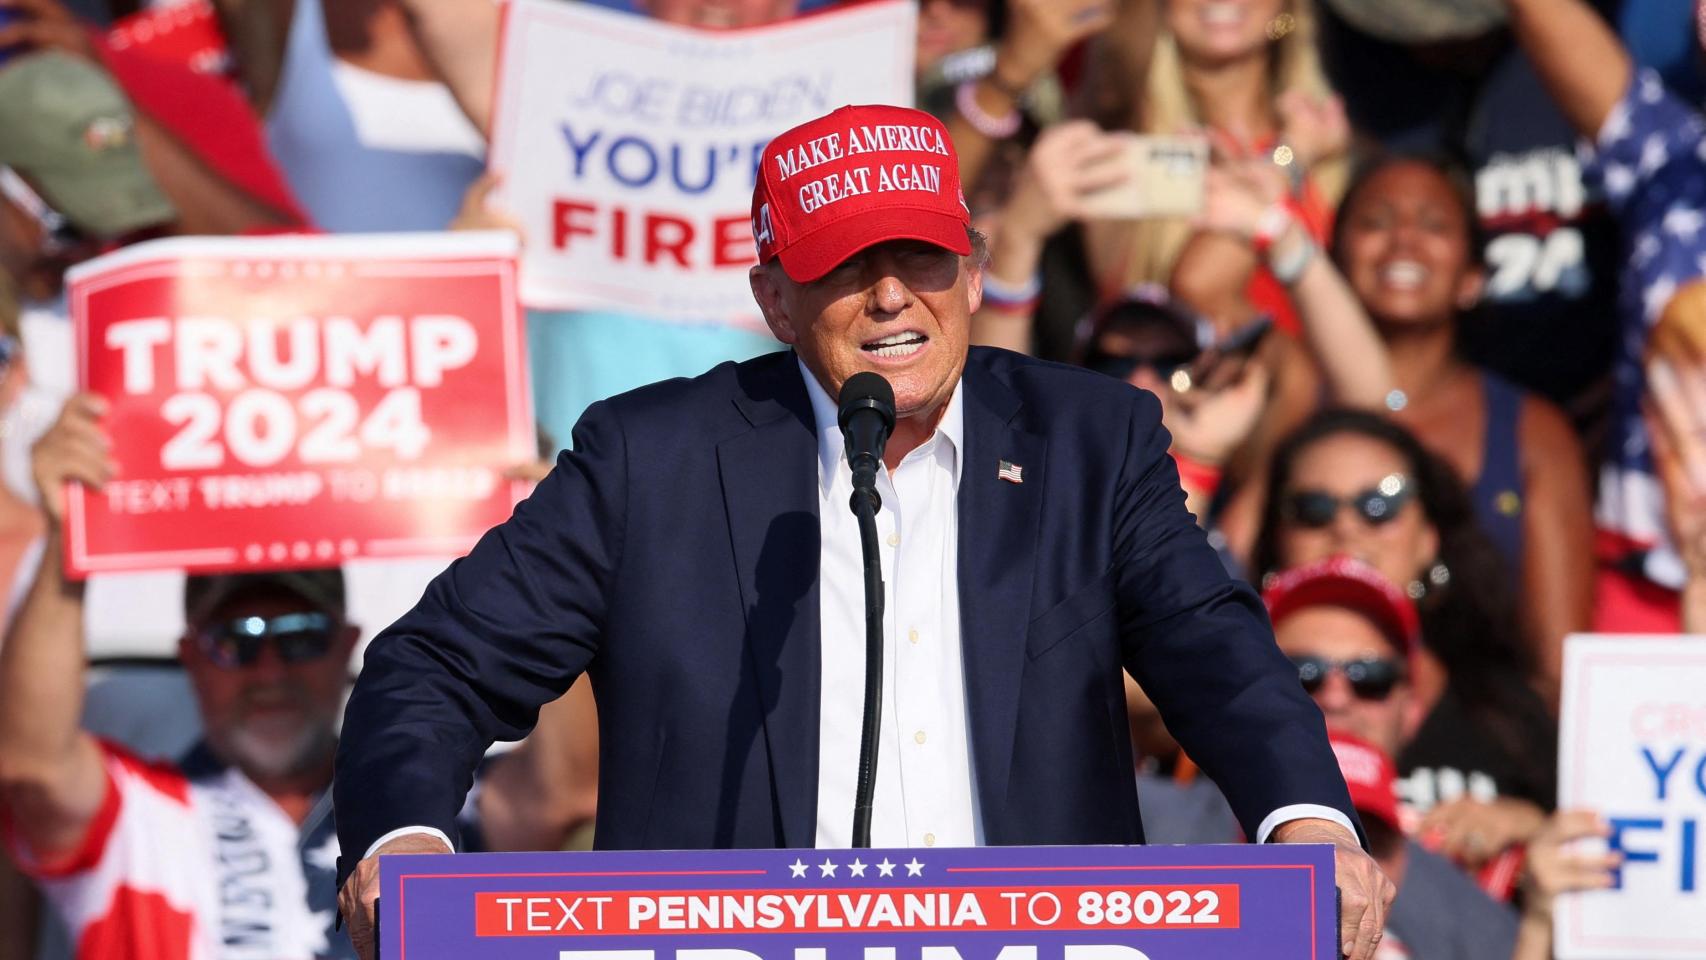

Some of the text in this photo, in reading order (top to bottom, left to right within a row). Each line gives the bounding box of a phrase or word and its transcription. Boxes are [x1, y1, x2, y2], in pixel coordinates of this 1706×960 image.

[568, 66, 834, 126] JOE BIDEN
[775, 125, 949, 181] MAKE AMERICA
[799, 164, 941, 214] GREAT AGAIN
[105, 314, 479, 395] TRUMP
[159, 386, 431, 471] 2024
[1640, 746, 1706, 800] Y
[496, 890, 1220, 932] TEXT PENNSYLVANIA TO 88022
